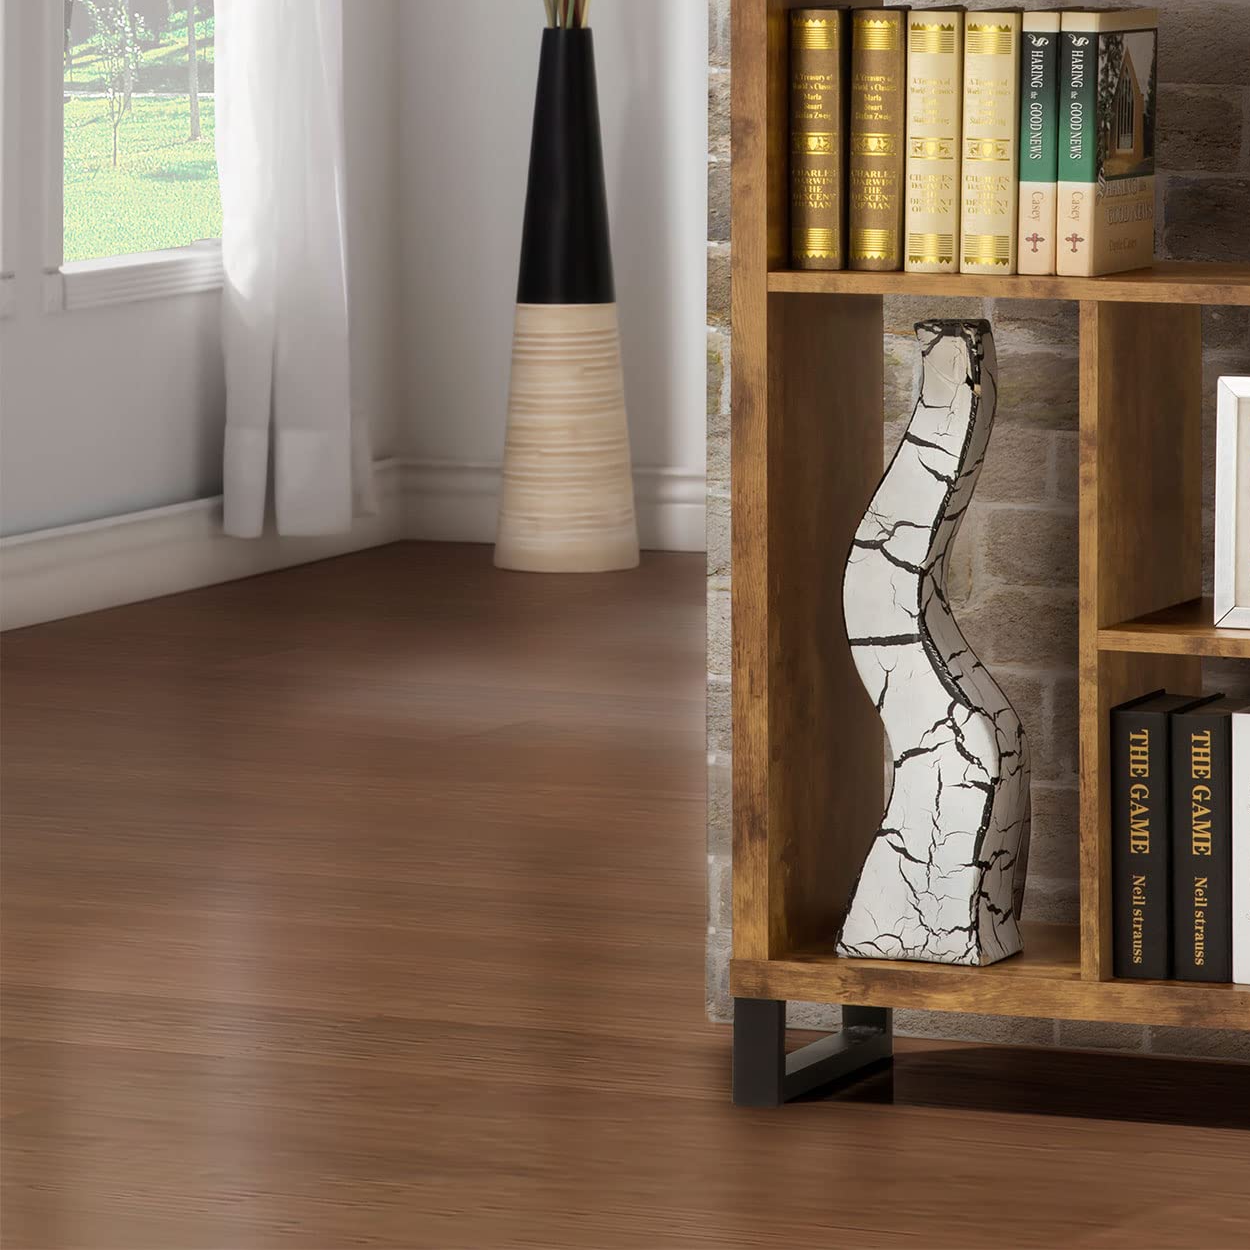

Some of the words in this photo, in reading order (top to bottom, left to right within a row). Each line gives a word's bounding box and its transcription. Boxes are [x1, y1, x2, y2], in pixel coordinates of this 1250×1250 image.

[1028, 33, 1050, 88] SHARING
[1068, 33, 1090, 88] SHARING
[1030, 102, 1044, 131] GOOD
[1070, 102, 1083, 131] GOOD
[1029, 132, 1044, 160] NEWS
[1069, 132, 1083, 160] NEWS
[863, 186, 882, 194] THE
[867, 201, 891, 210] MAN
[1029, 191, 1045, 222] Casey
[1069, 191, 1084, 222] Casey
[1129, 728, 1149, 778] THE
[1190, 729, 1212, 779] THE
[1129, 783, 1150, 855] GAME
[1190, 784, 1212, 856] GAME
[1131, 873, 1147, 905] Neil
[1193, 876, 1209, 908] Neil
[1131, 906, 1147, 964] strauss
[1193, 908, 1208, 966] strauss
